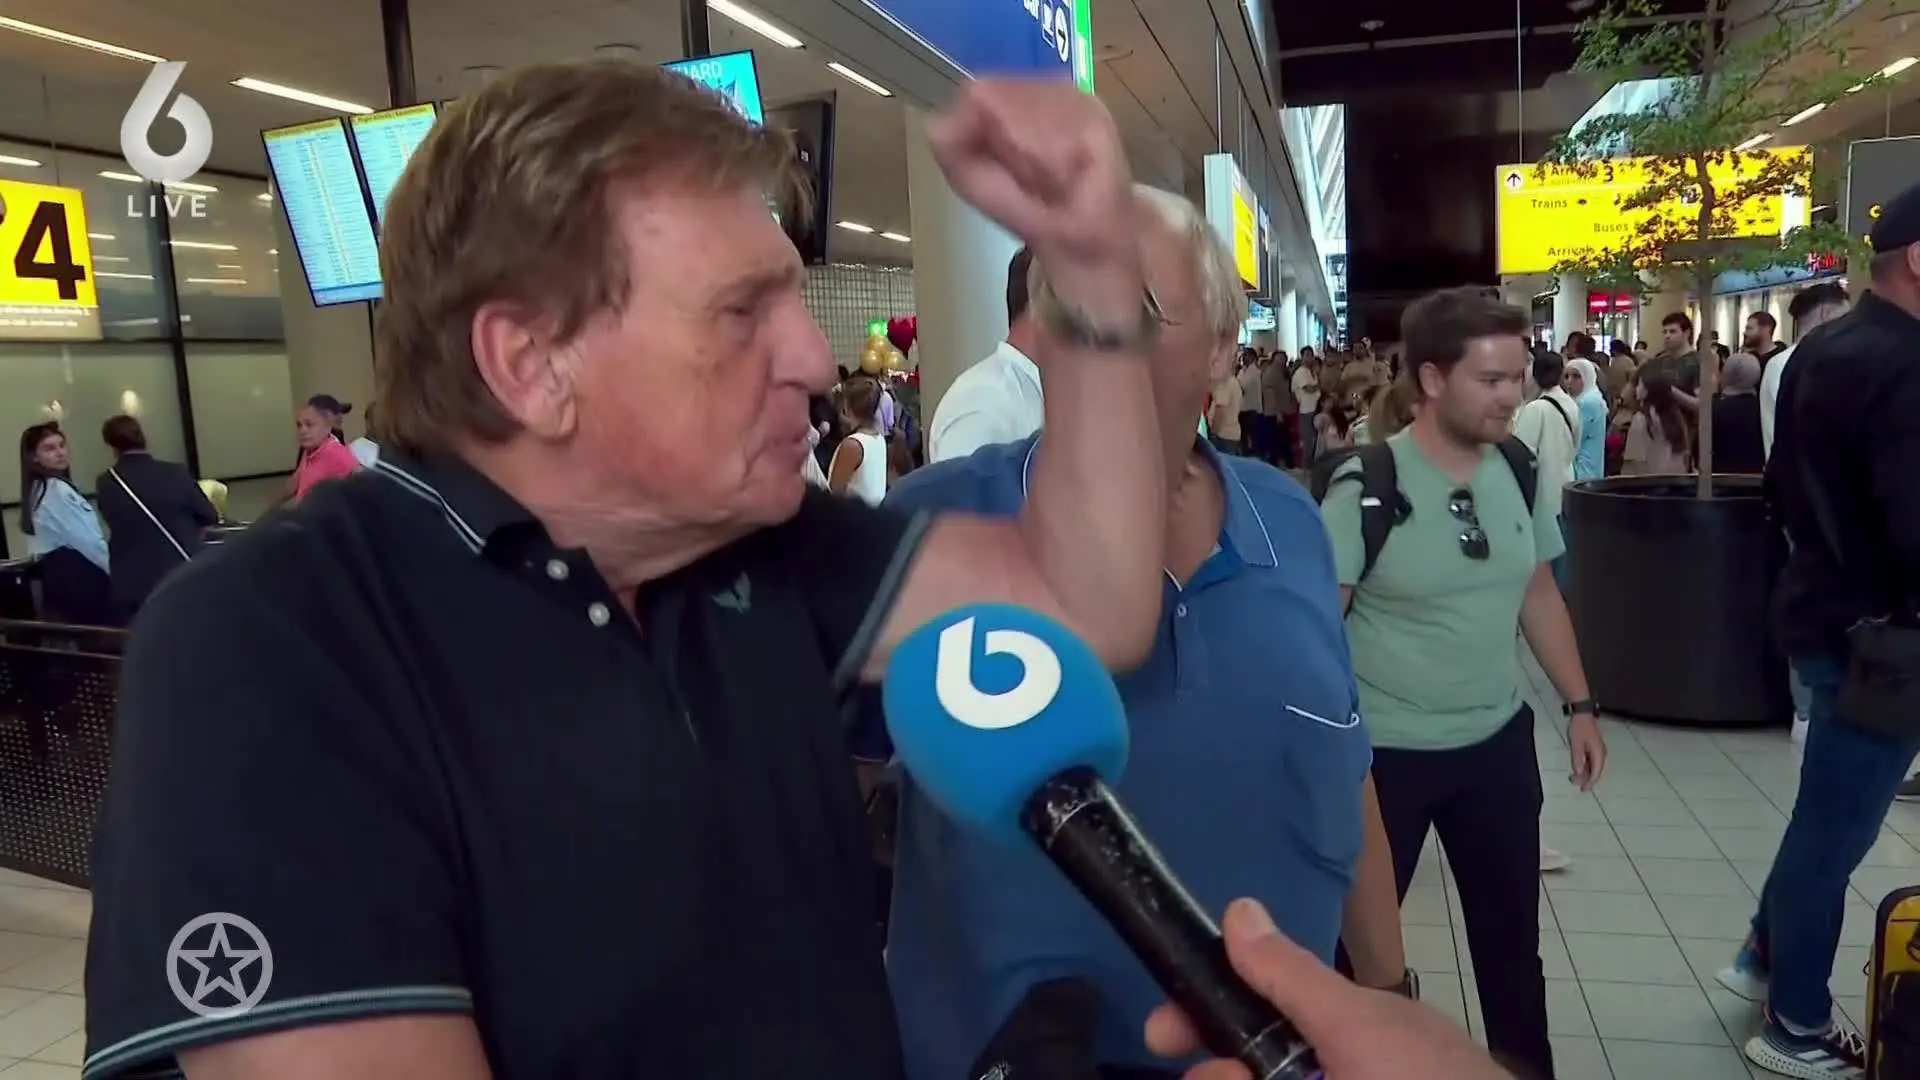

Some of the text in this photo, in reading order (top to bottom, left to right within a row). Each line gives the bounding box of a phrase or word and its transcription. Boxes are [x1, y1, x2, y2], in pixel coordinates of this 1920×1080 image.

[1550, 163, 1597, 178] Arri
[1603, 163, 1614, 182] 3
[1531, 199, 1568, 209] Trains
[1593, 222, 1629, 233] Buses
[14, 201, 86, 300] 4
[1547, 245, 1595, 257] Arrivals
